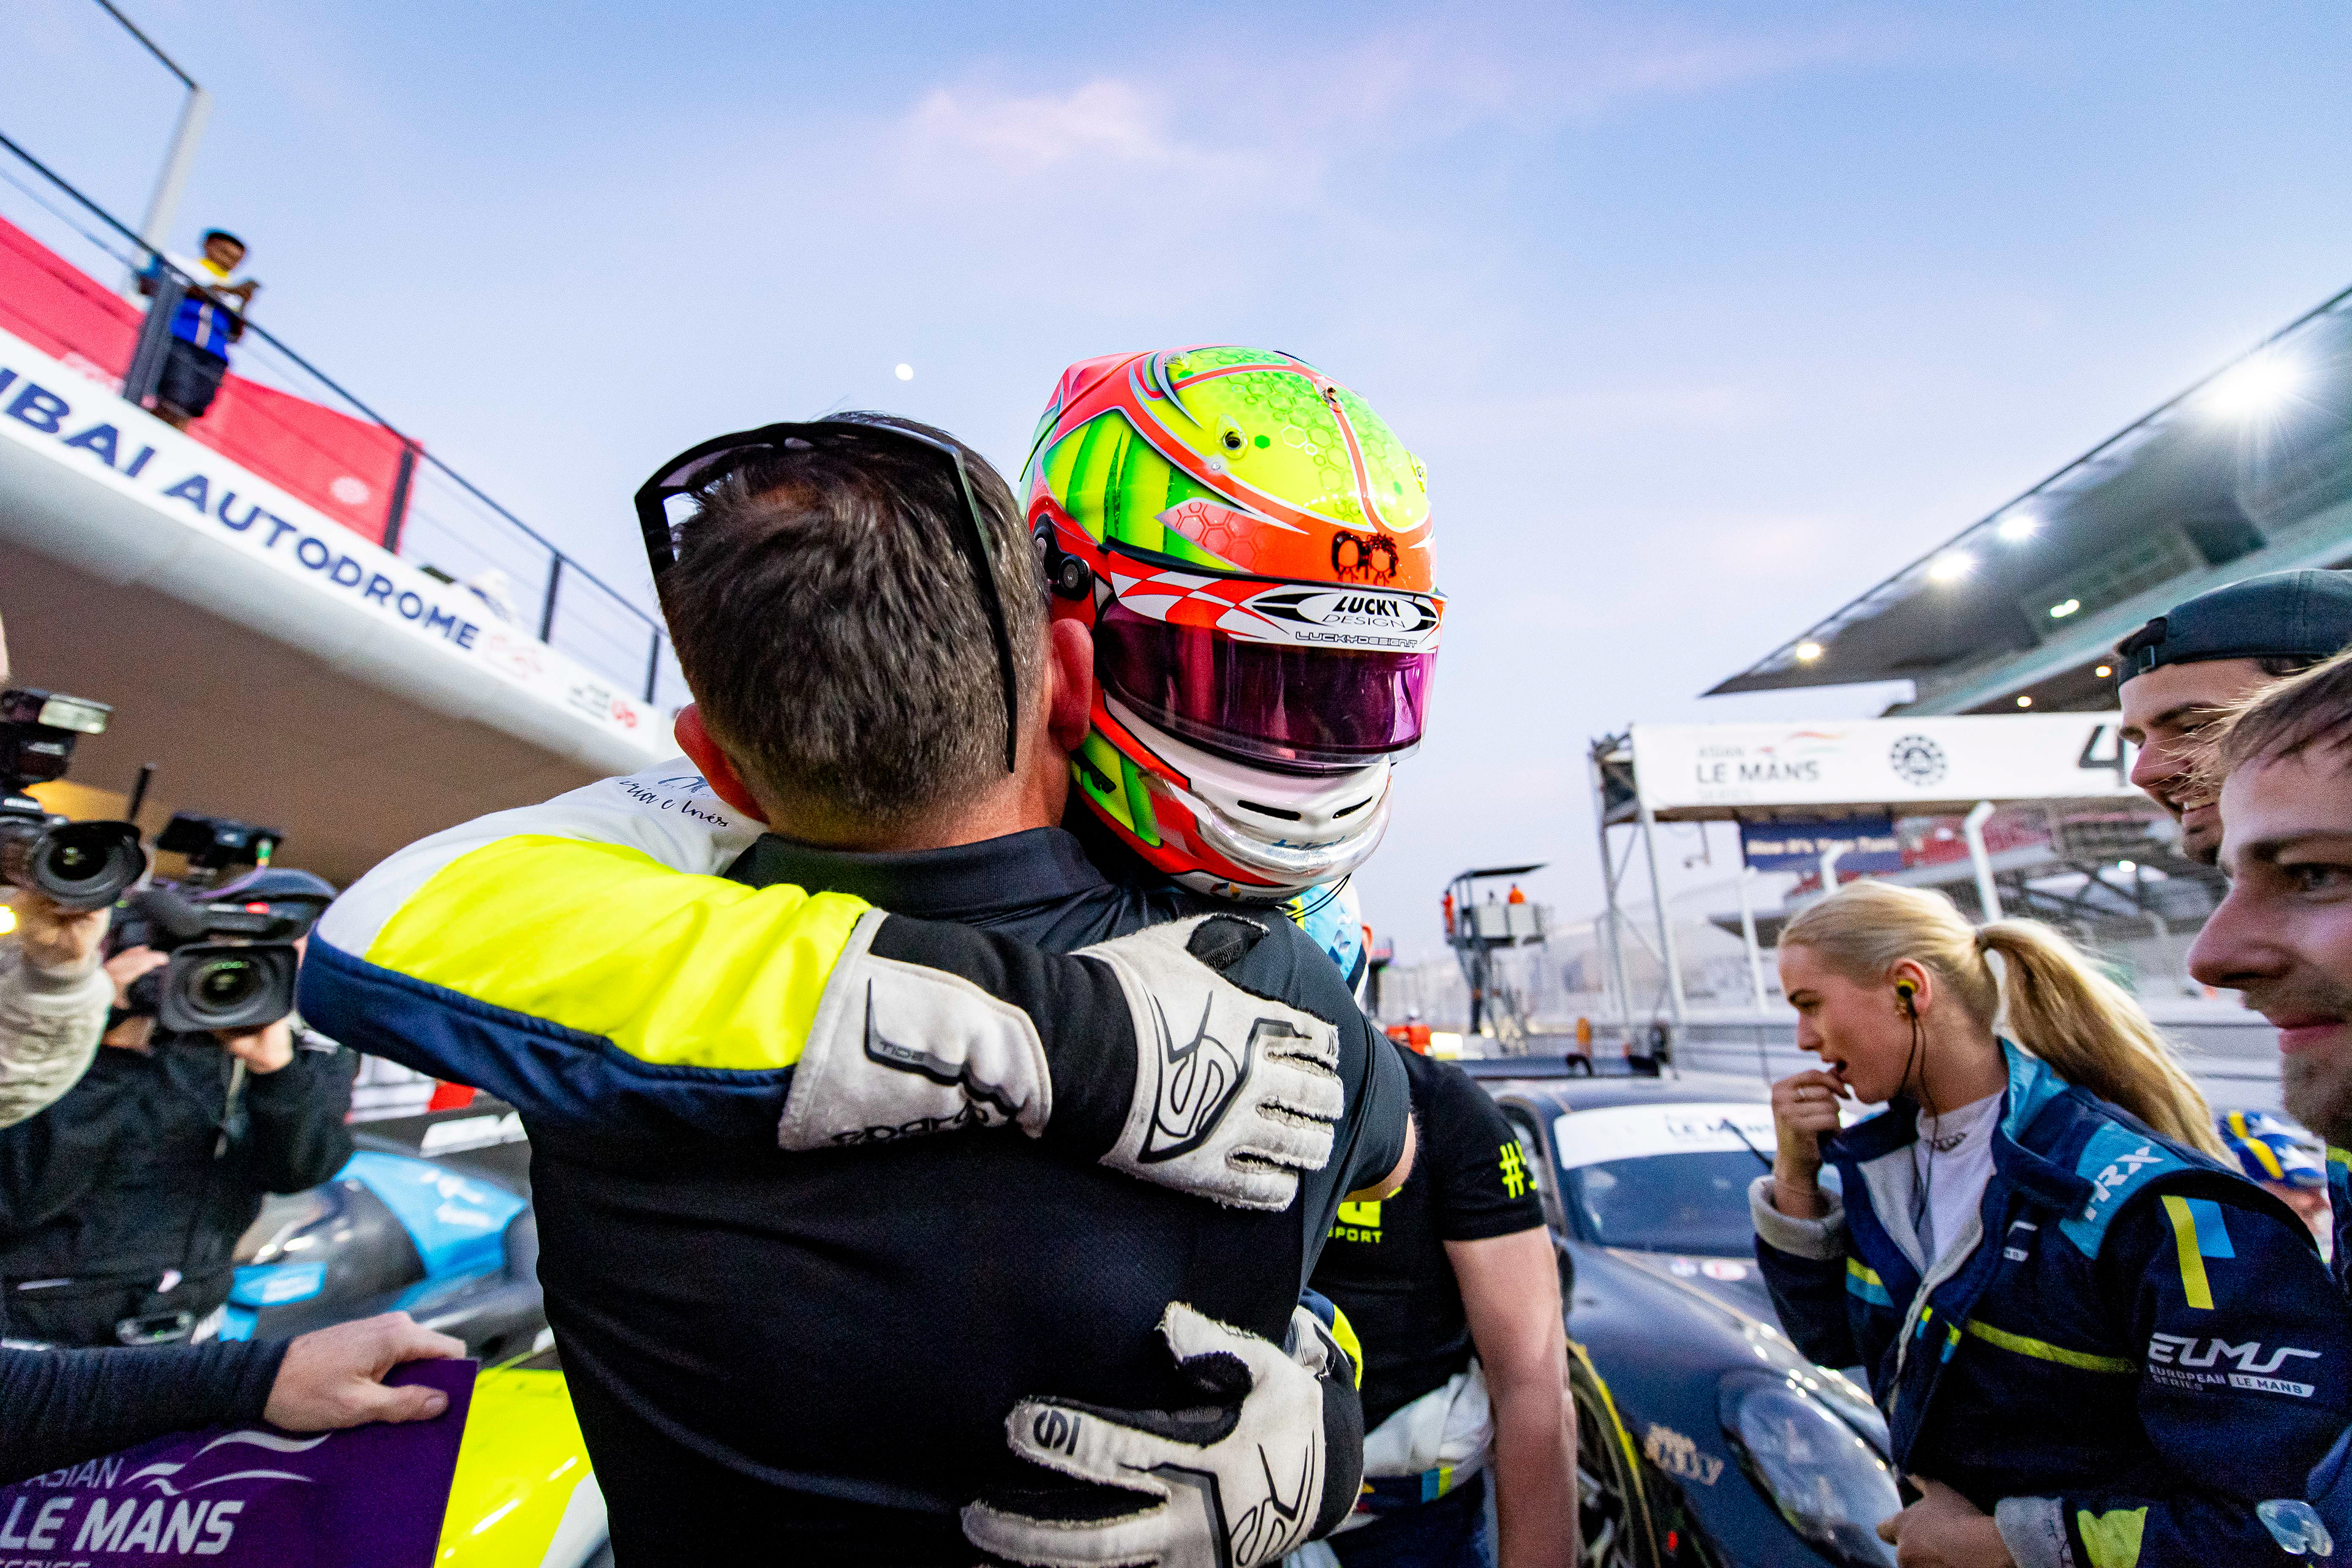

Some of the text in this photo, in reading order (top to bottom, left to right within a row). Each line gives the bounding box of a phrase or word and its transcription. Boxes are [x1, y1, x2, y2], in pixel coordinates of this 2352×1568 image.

[0, 368, 480, 650] BAI AUTODROME
[1322, 614, 1406, 628] DESIGN
[1332, 595, 1400, 617] LUCKY
[1696, 761, 1727, 786] LE
[2148, 1332, 2323, 1373] ELMS
[2149, 1363, 2304, 1394] EUROPEAN LE MANS
[0, 1496, 75, 1550] LE
